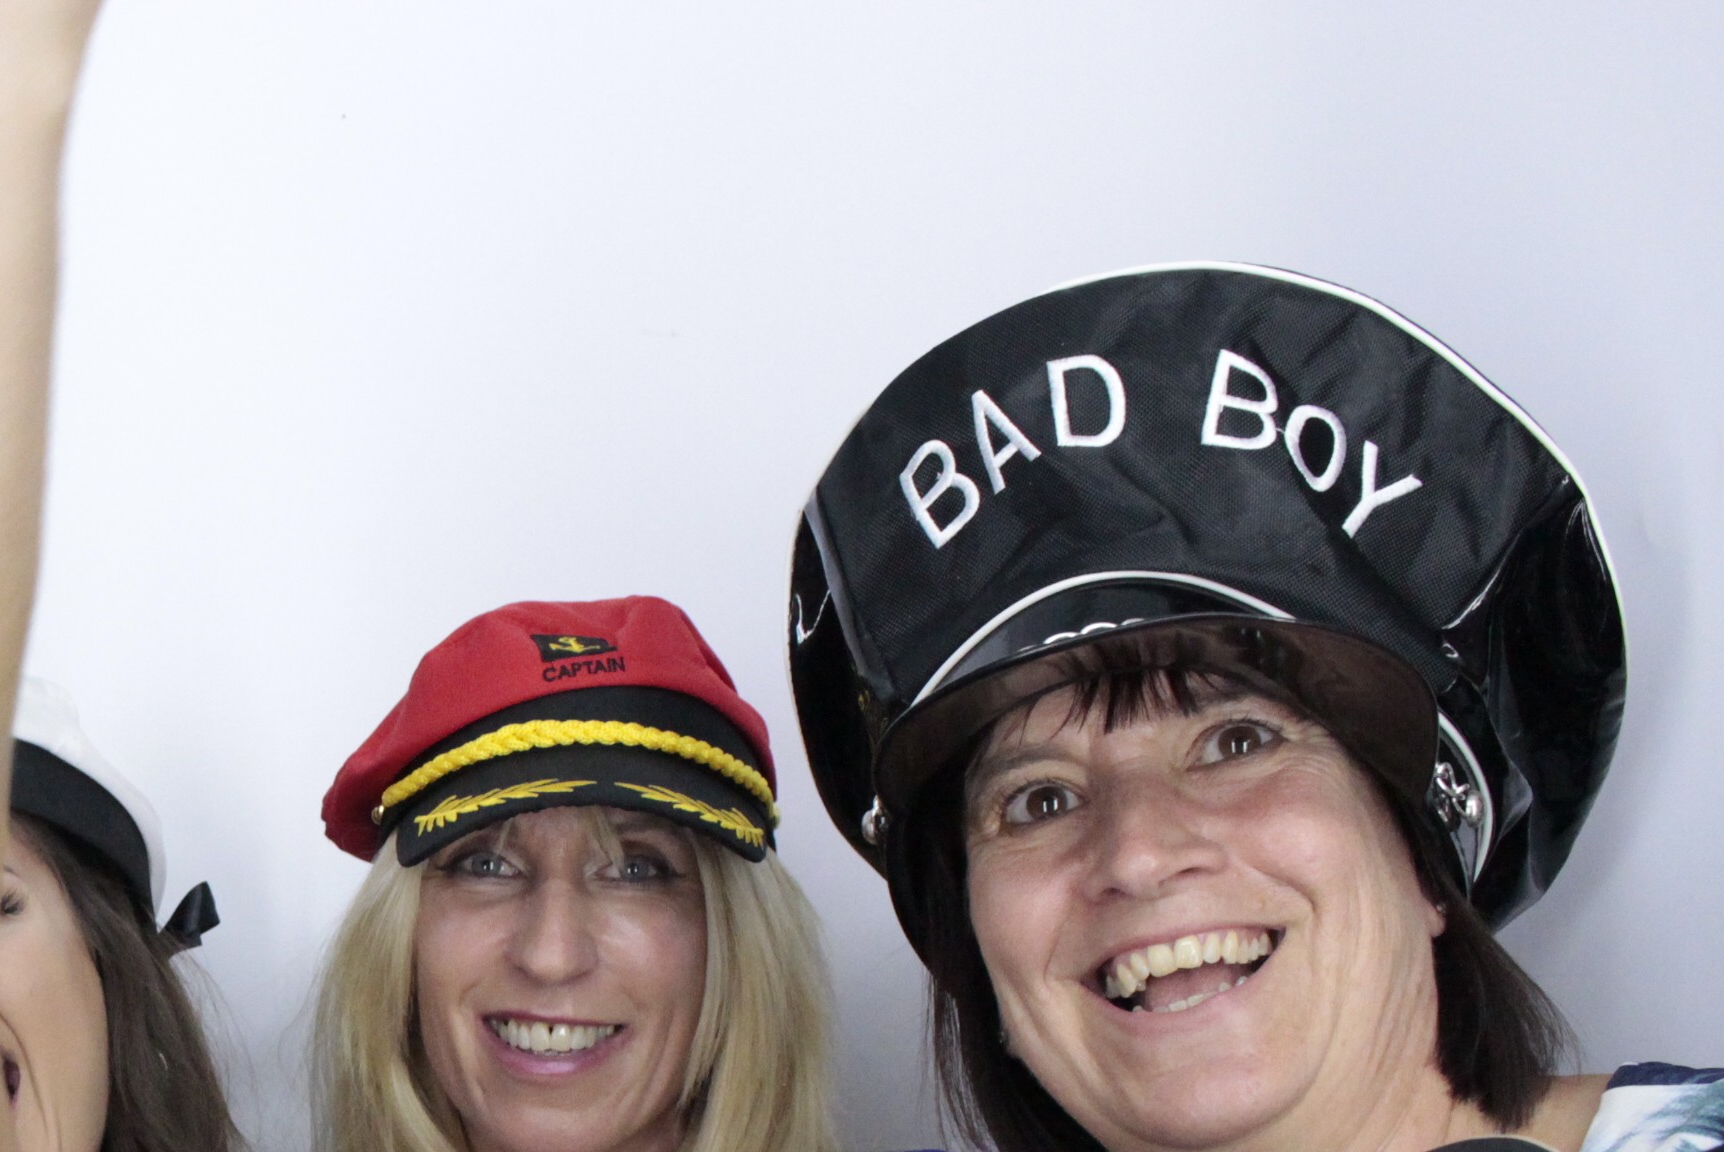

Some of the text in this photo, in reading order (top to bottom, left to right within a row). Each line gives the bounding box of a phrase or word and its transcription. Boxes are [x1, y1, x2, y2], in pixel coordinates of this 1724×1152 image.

[898, 349, 1423, 550] BAD BOY
[542, 656, 626, 683] CAPTAIN
